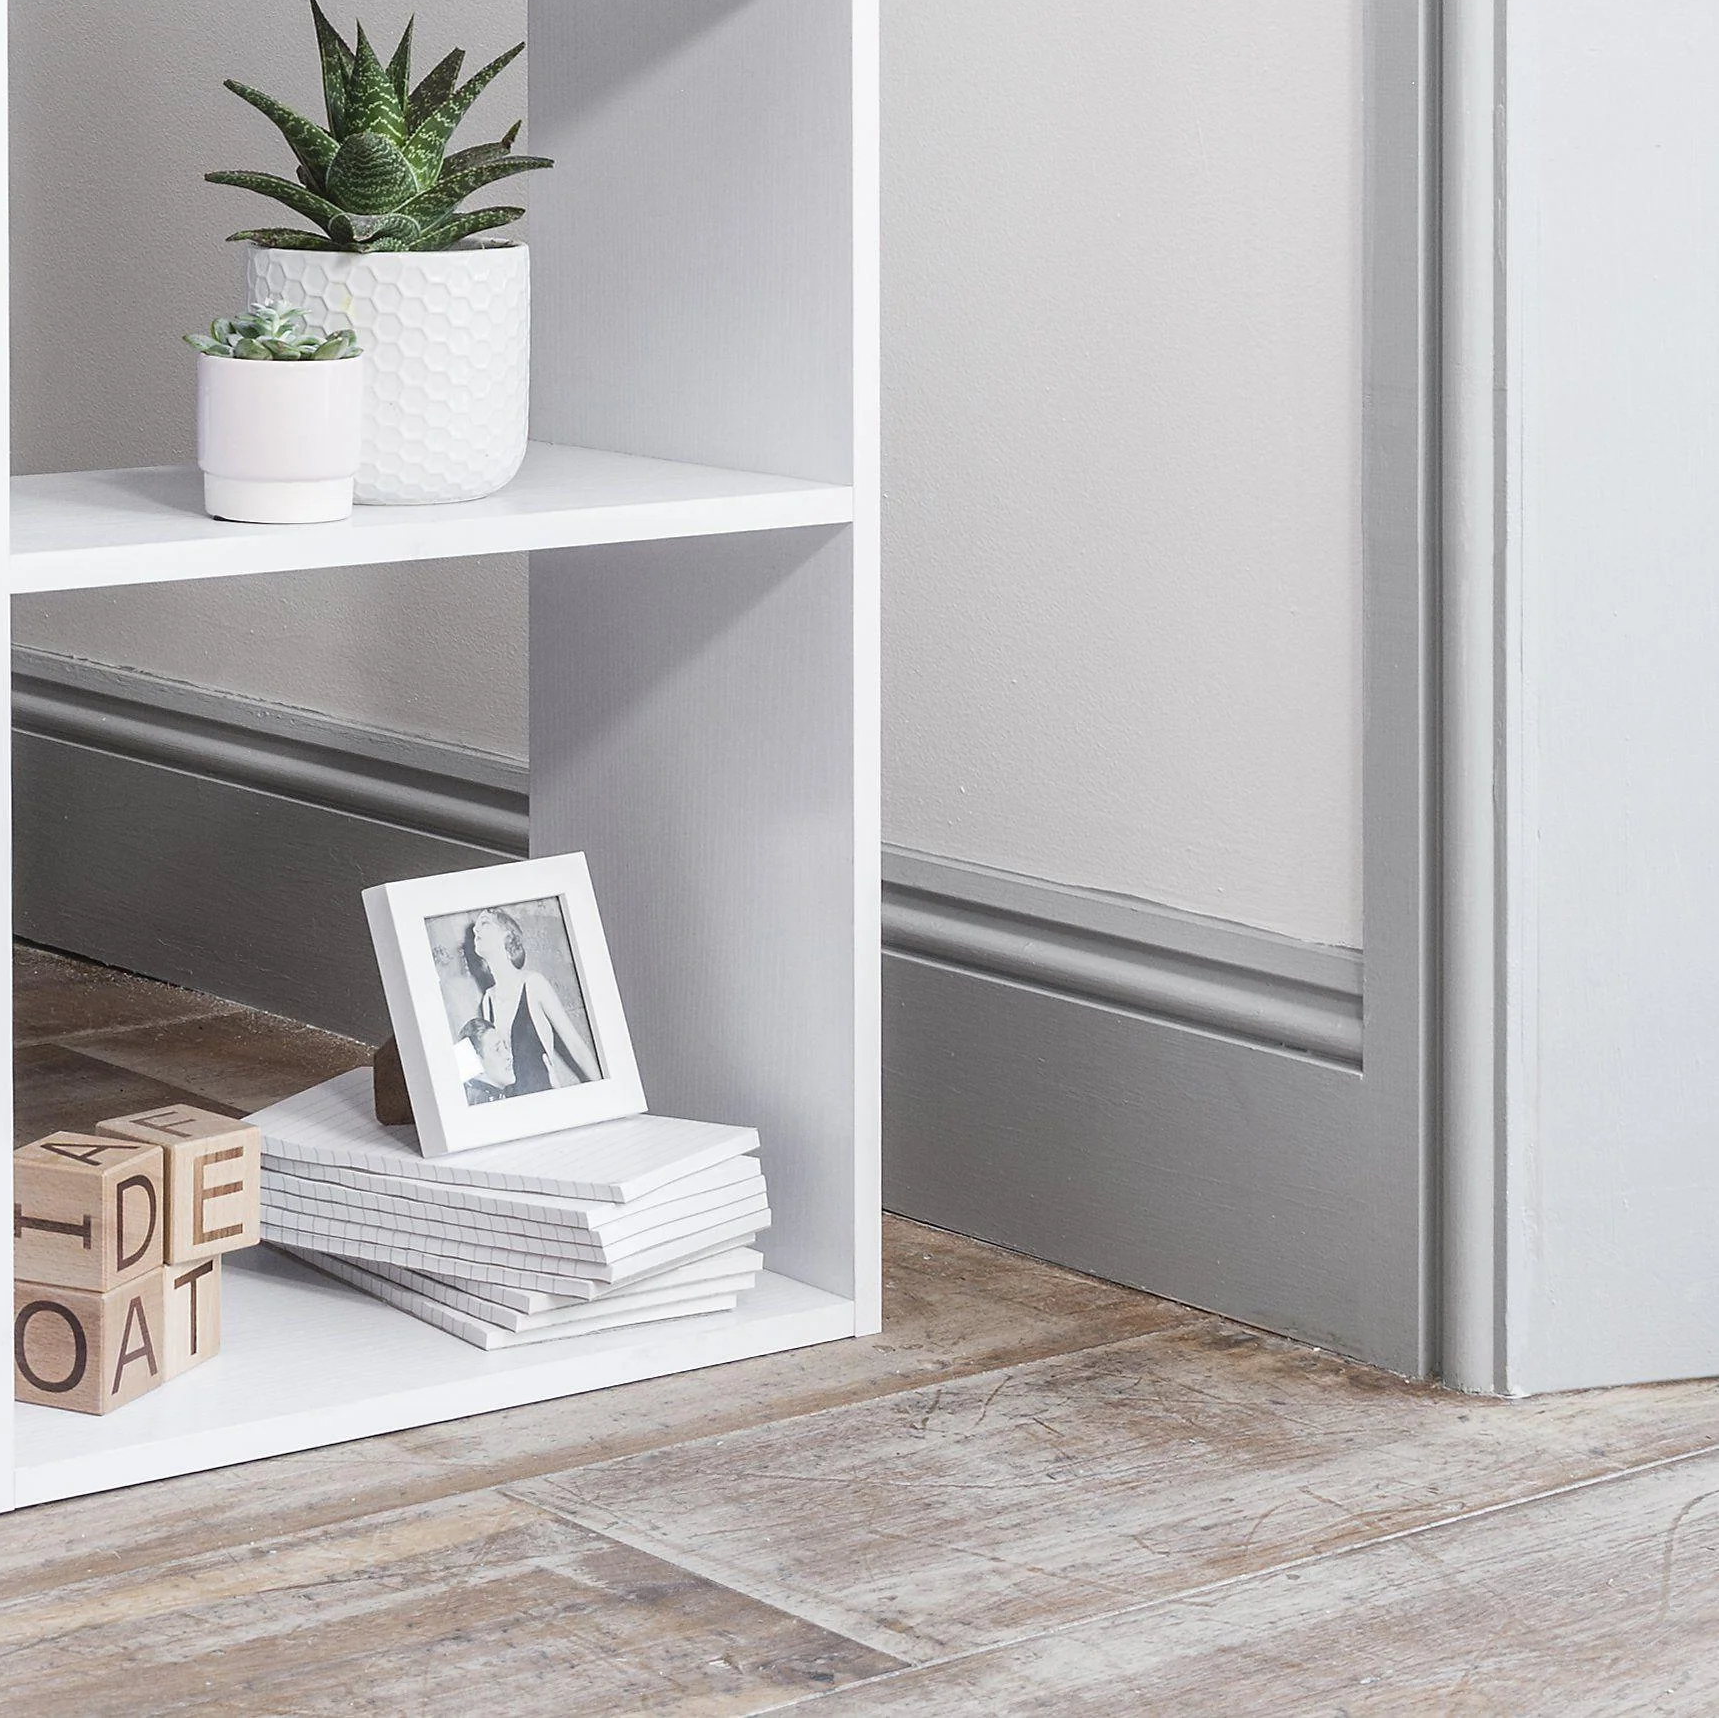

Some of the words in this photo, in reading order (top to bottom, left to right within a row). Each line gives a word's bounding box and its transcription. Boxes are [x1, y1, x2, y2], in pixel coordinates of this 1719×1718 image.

[116, 1174, 157, 1272] D
[193, 1146, 244, 1246] E
[15, 1299, 87, 1393] O
[111, 1296, 158, 1396] A
[174, 1259, 213, 1355] T
